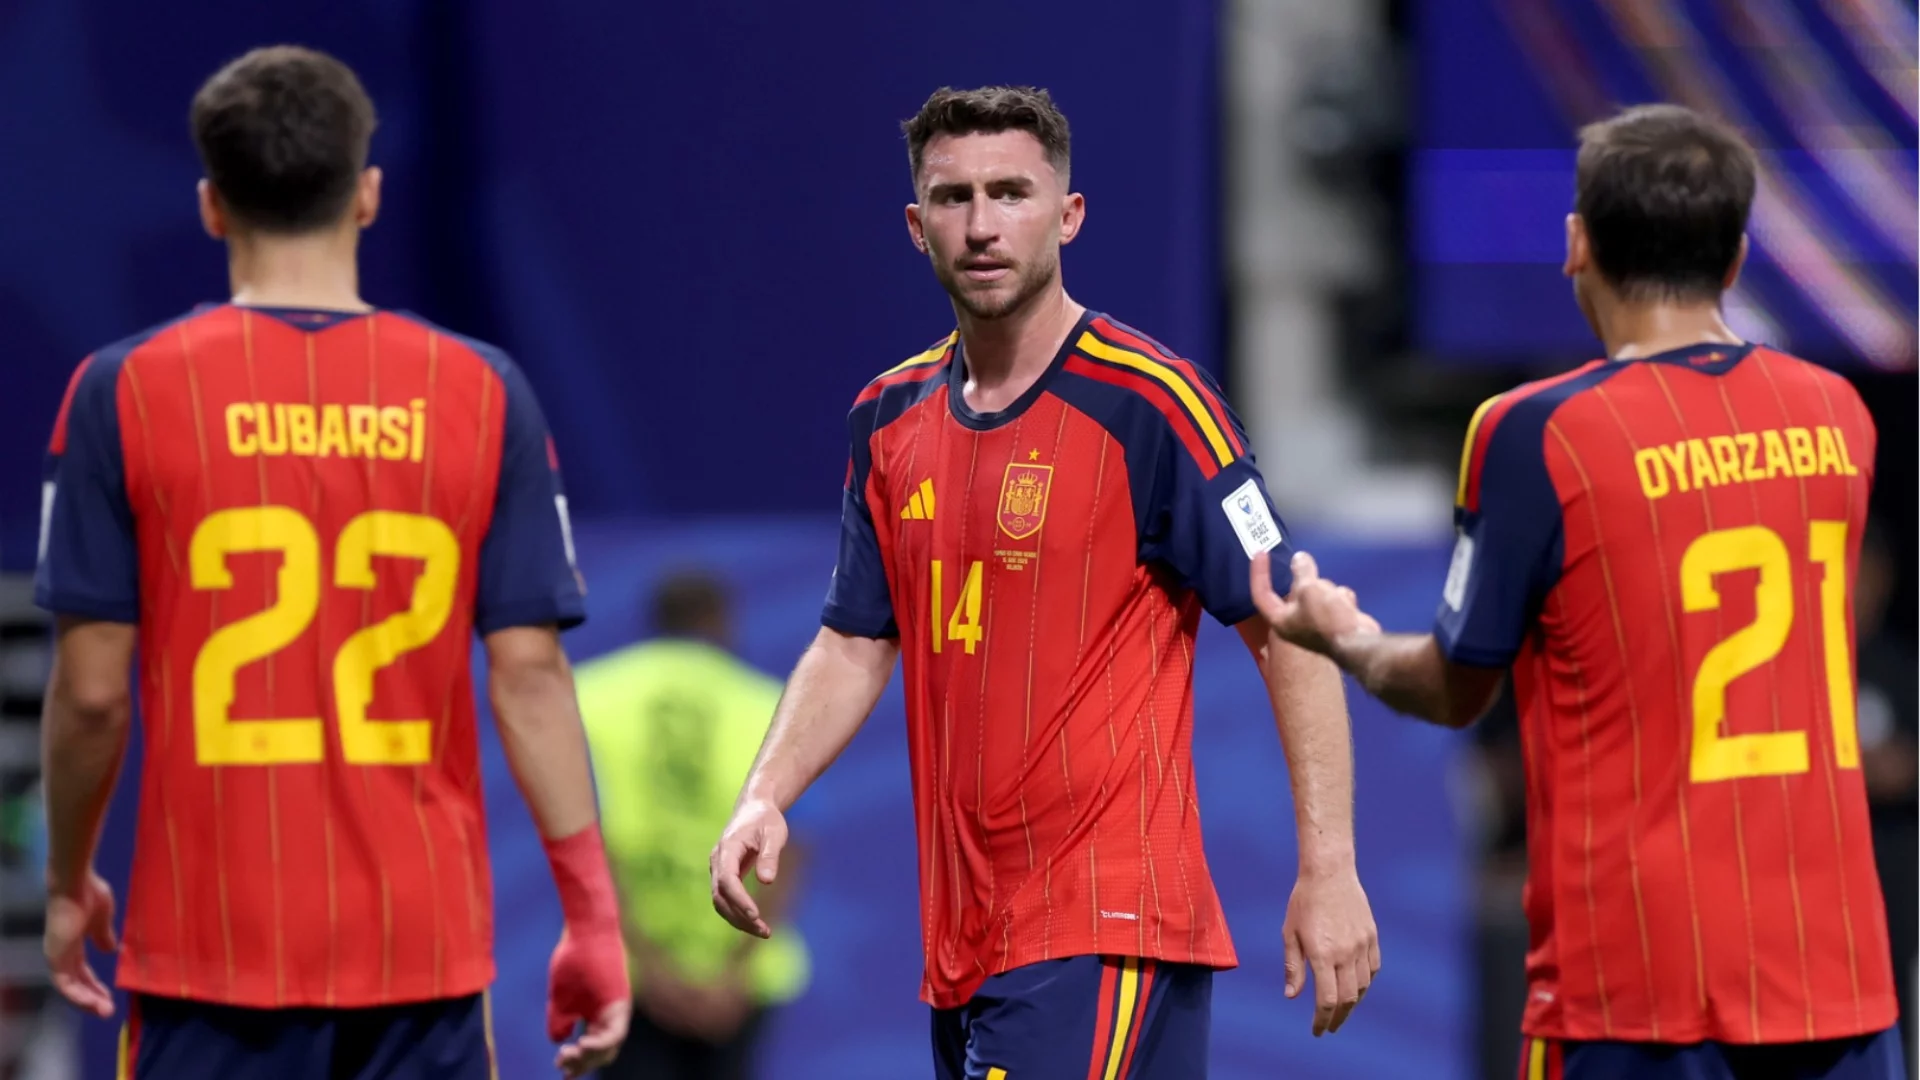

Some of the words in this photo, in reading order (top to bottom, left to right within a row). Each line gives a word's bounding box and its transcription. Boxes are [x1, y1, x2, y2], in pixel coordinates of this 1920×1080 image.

[225, 398, 427, 463] CUBARSÍ
[1634, 426, 1859, 500] OYARZABAL
[189, 506, 461, 766] 22
[931, 559, 984, 656] 14
[1680, 520, 1860, 783] 21
